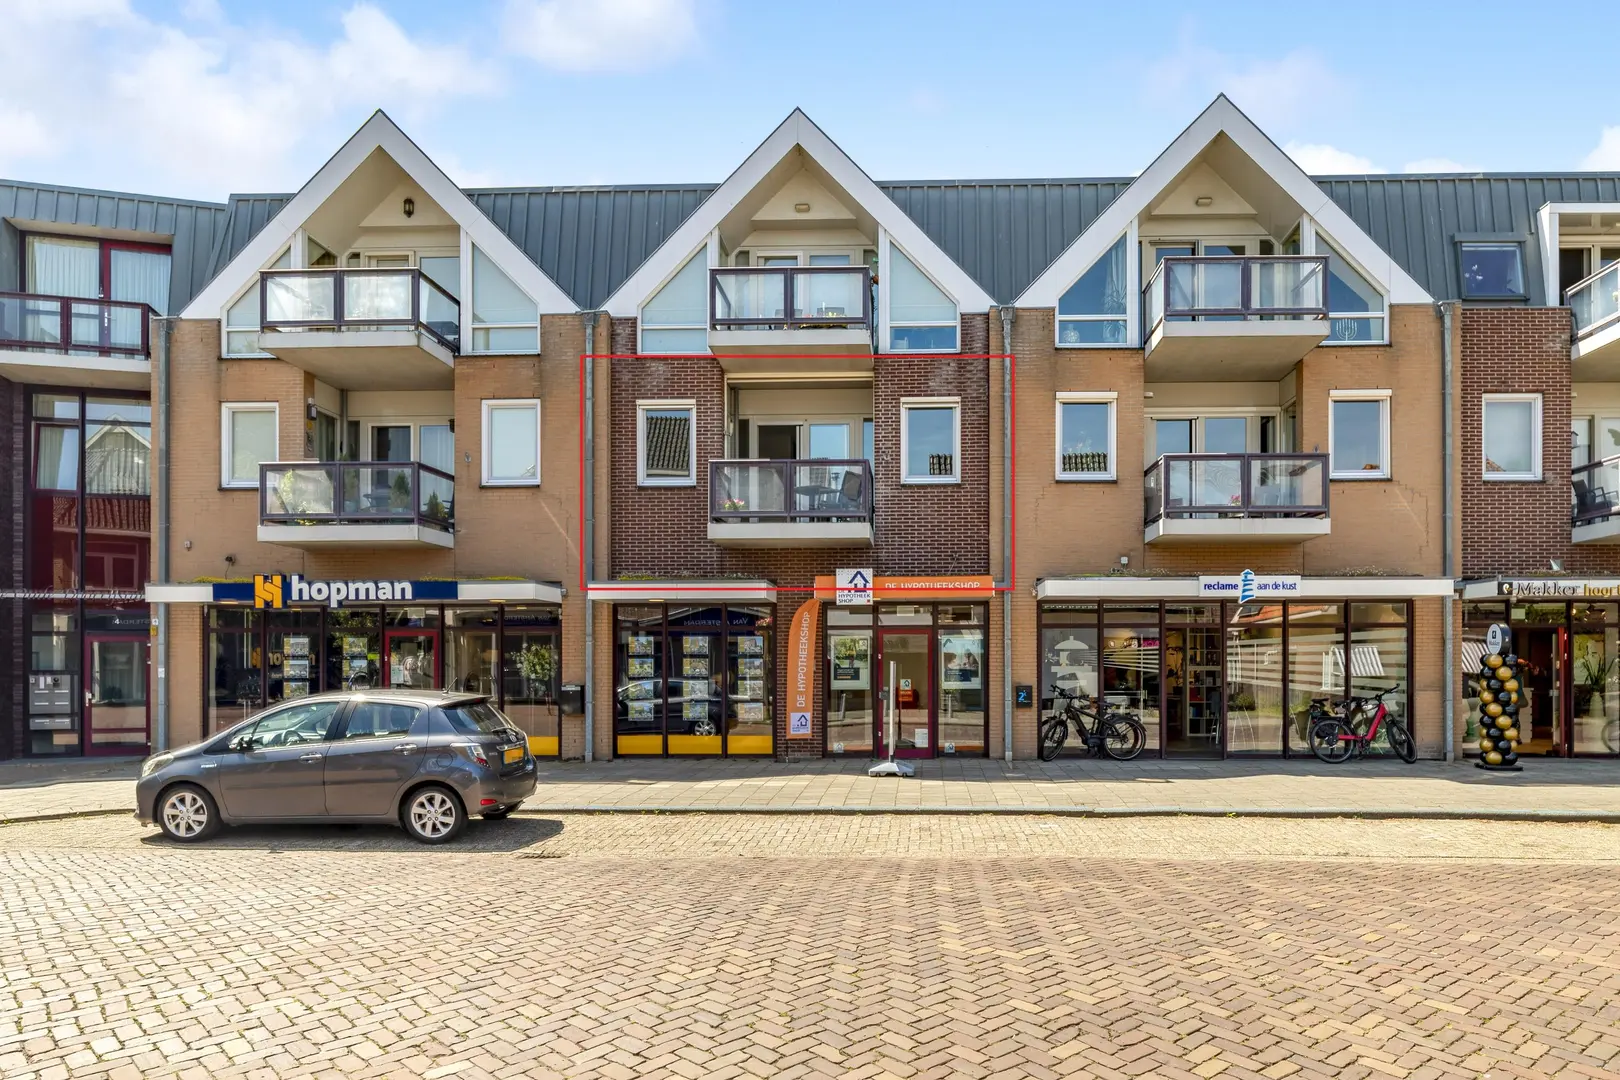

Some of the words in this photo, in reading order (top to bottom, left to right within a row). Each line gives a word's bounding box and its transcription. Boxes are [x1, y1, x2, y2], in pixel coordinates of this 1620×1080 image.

[291, 575, 413, 608] hopman
[1203, 581, 1239, 591] reclame
[1256, 583, 1271, 591] aan
[1271, 581, 1281, 591] de
[1281, 581, 1298, 591] kust
[1516, 582, 1581, 597] Makker
[797, 611, 811, 692] HYPOTHEEKSHOP
[796, 694, 806, 708] DE
